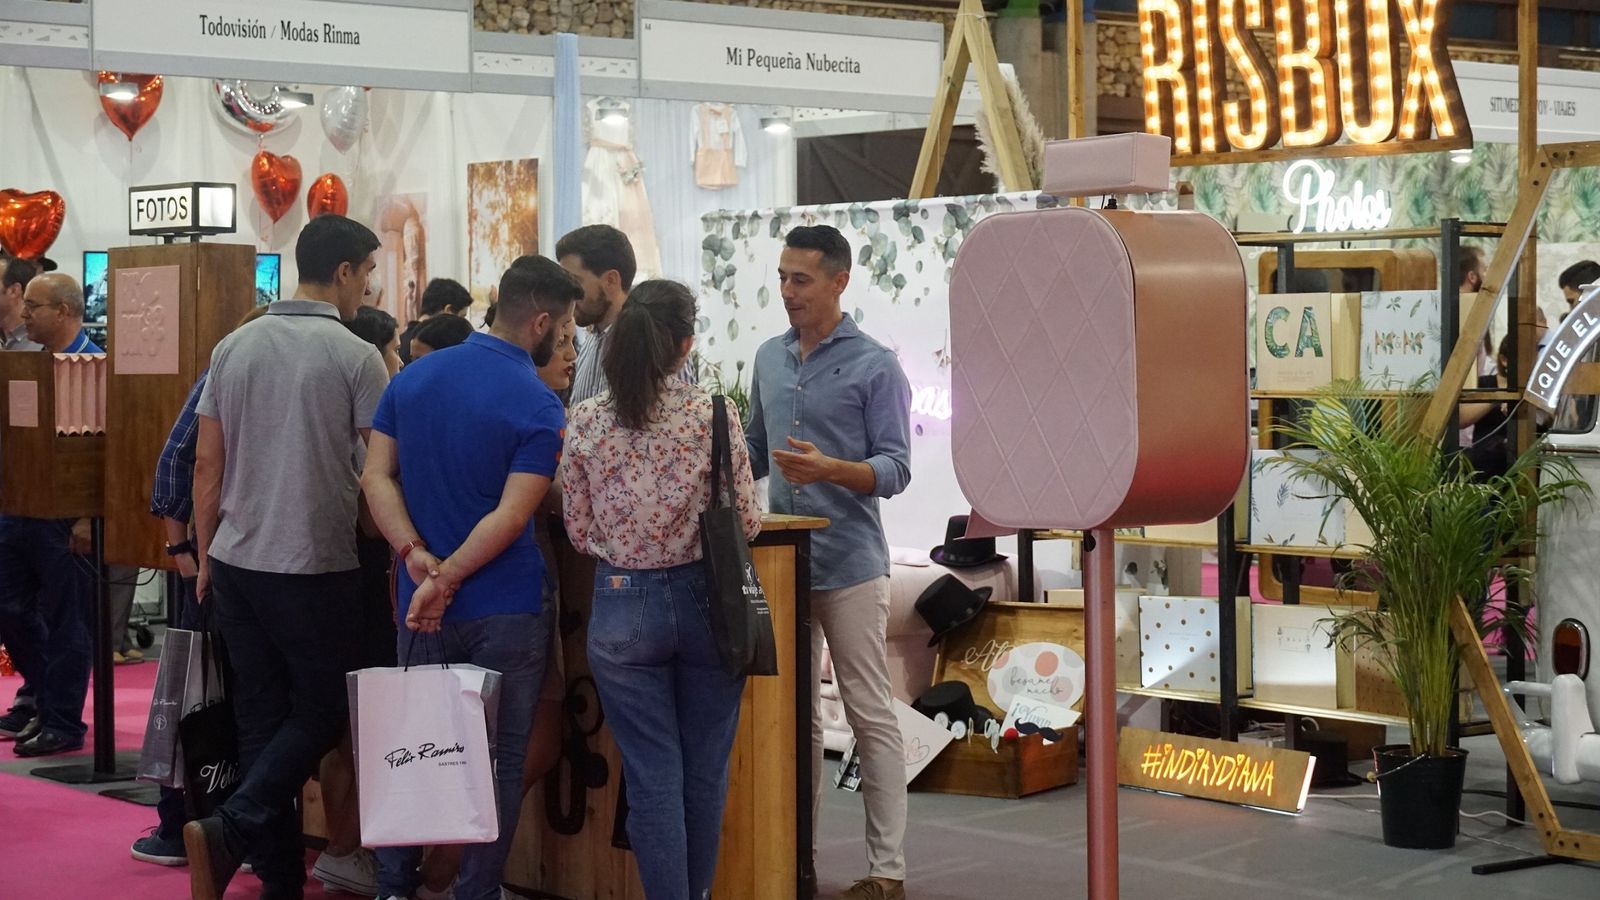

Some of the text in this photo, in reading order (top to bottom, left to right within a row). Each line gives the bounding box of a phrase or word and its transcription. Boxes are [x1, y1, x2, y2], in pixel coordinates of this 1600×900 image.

[199, 14, 266, 40] Todovisión
[280, 20, 319, 43] Modas
[323, 23, 360, 46] Rinma
[726, 46, 861, 74] Mi Pequeña Nubecita
[136, 195, 188, 222] FOTOS
[1283, 159, 1392, 235] Photos
[1264, 306, 1324, 359] CA
[1571, 311, 1598, 338] EL
